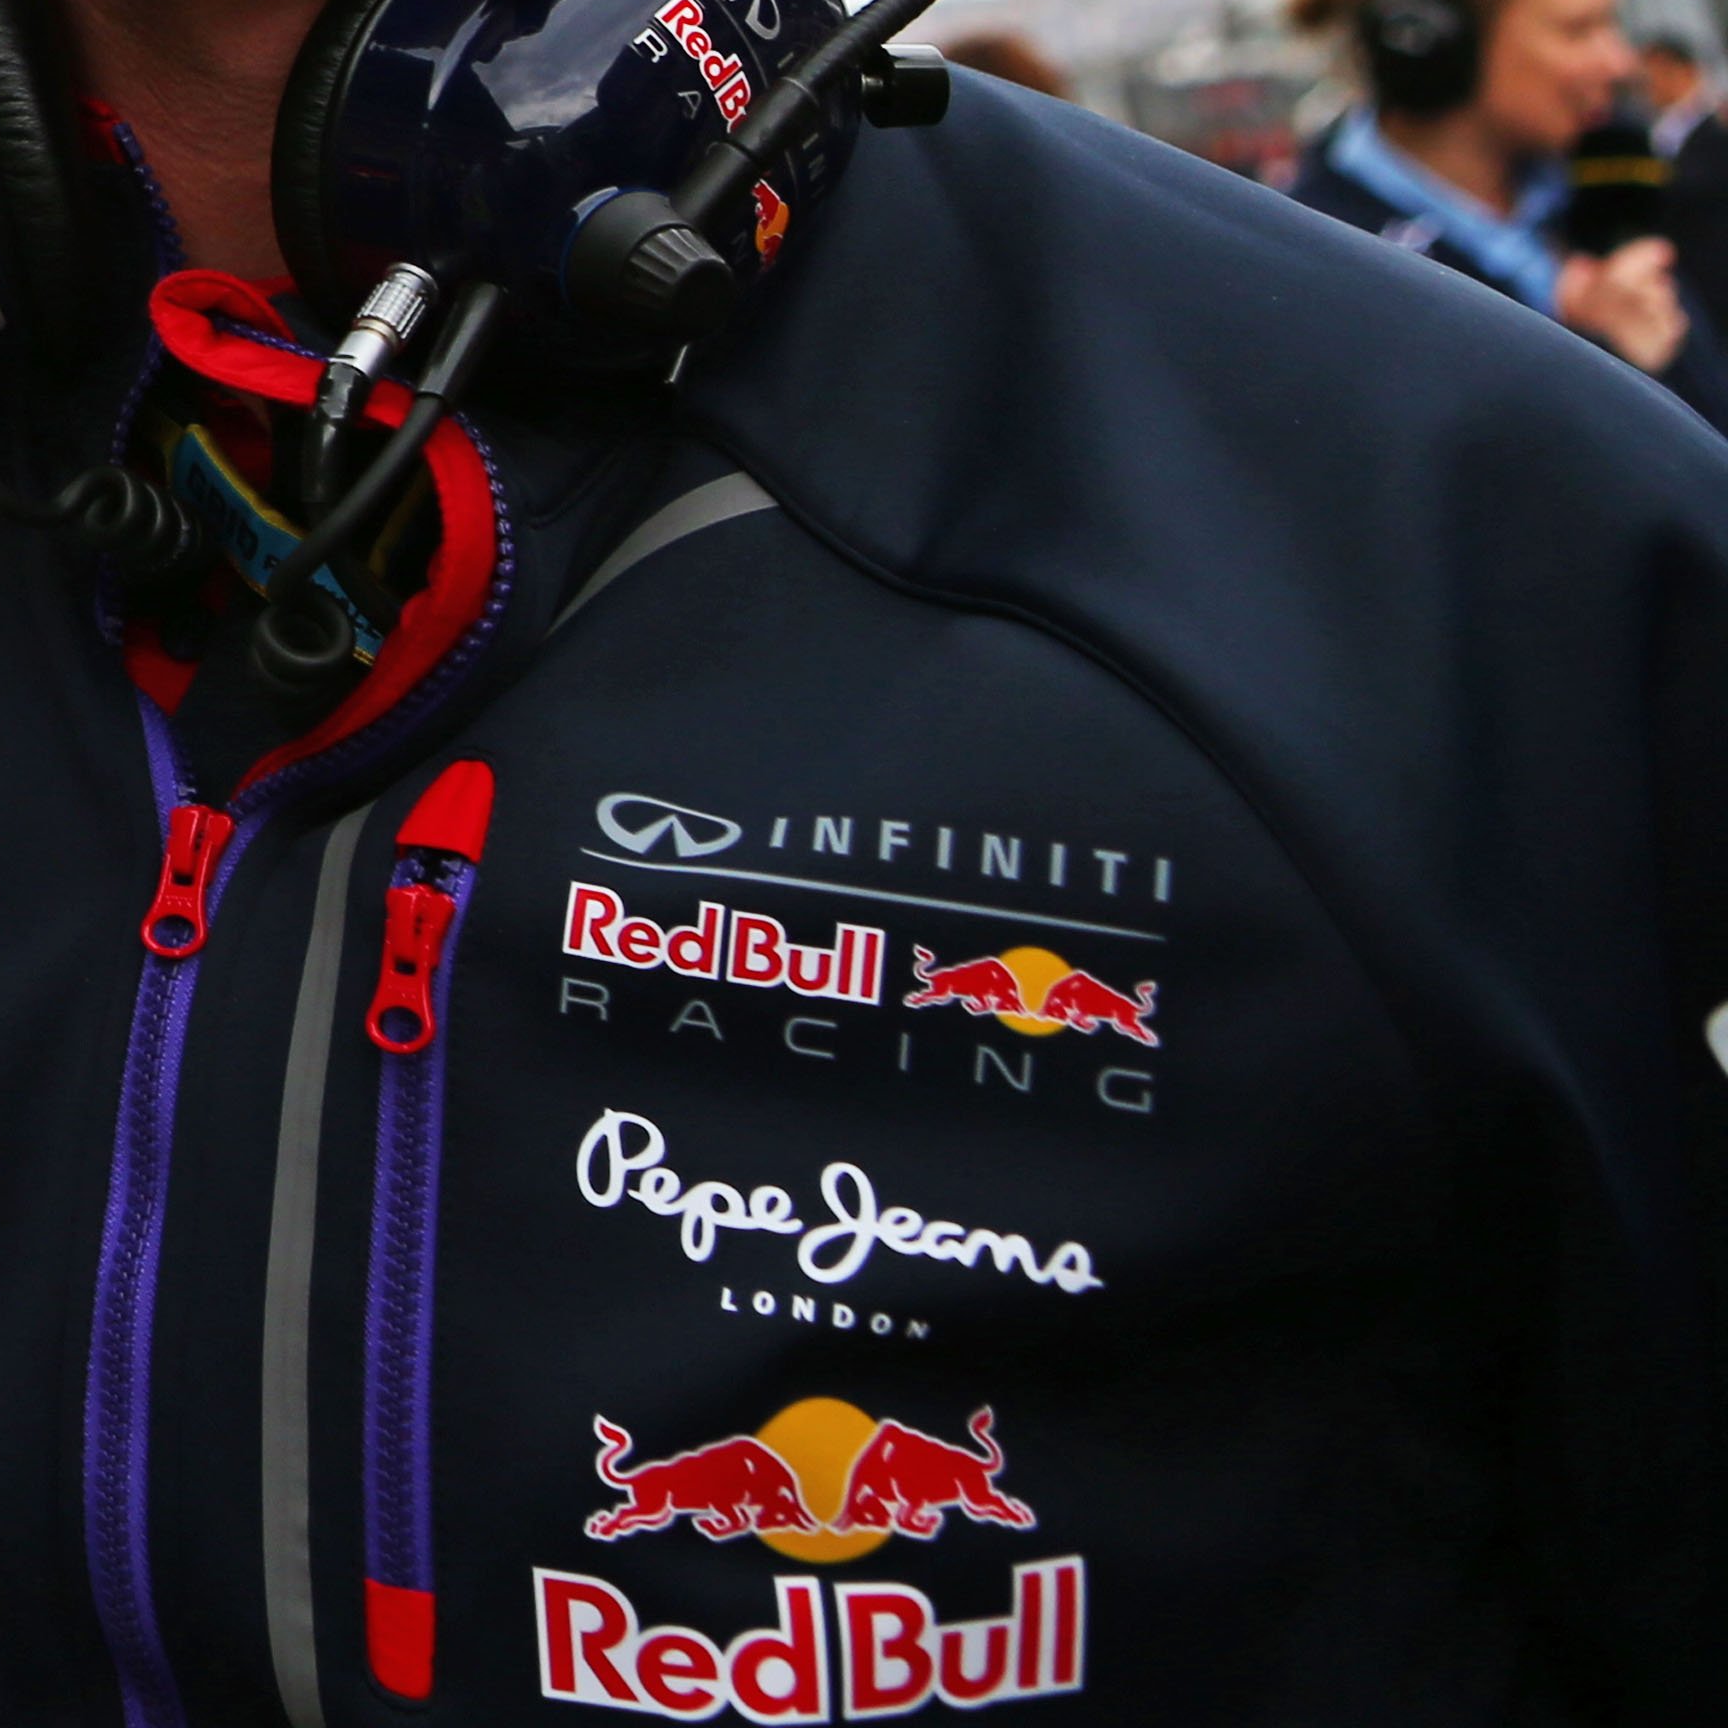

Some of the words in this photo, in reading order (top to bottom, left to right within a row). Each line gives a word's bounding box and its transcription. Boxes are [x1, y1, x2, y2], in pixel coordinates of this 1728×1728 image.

[769, 817, 1170, 903] INFINITI
[559, 976, 1153, 1114] RACING
[576, 1108, 804, 1262] Pepe
[796, 1161, 1105, 1294] Jeans
[721, 1286, 931, 1339] LONDON
